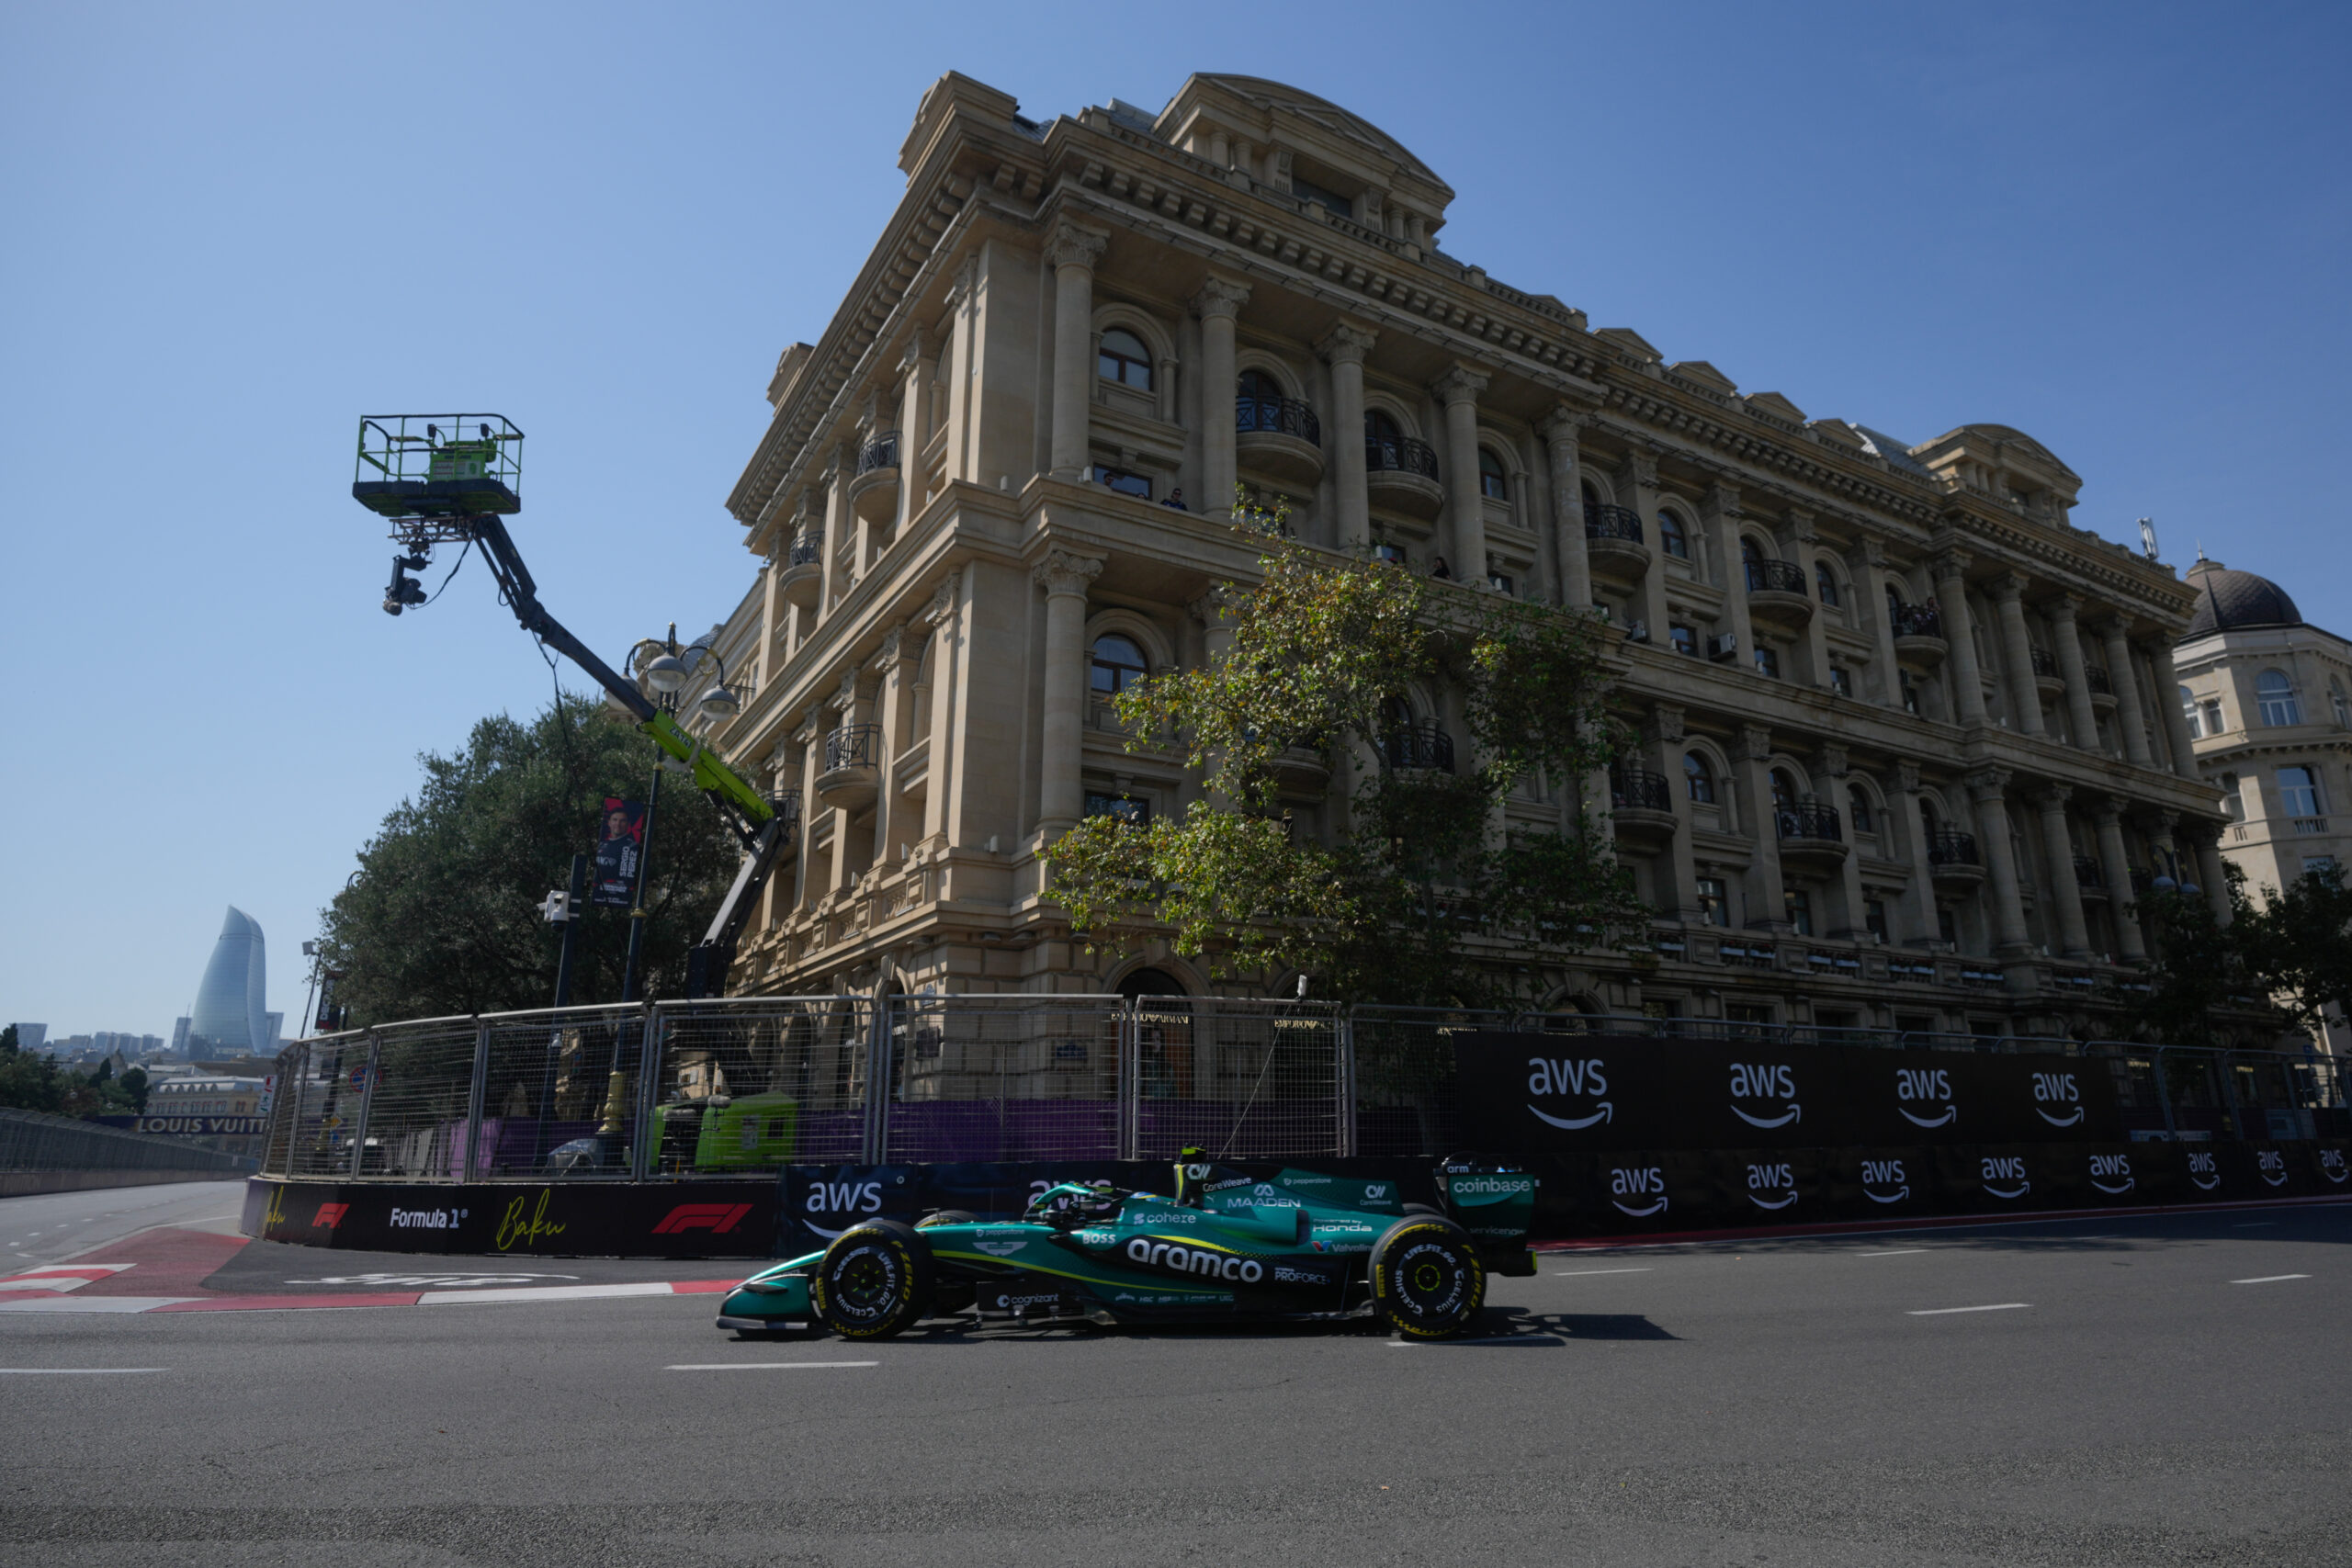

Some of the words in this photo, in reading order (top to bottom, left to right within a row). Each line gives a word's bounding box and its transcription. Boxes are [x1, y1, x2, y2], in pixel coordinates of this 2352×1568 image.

[619, 846, 630, 877] SERGIO
[627, 851, 638, 878] PEREZ
[1159, 1014, 1189, 1024] ARMANI
[1528, 1057, 1607, 1096] aws
[1730, 1063, 1795, 1099] aws
[1896, 1068, 1951, 1100] aws
[2032, 1072, 2079, 1102] aws
[138, 1118, 202, 1133] LOUIS
[1981, 1156, 2026, 1179] aws
[2089, 1154, 2131, 1177] aws
[2188, 1152, 2215, 1173] aws
[2256, 1151, 2283, 1170] aws
[2319, 1149, 2345, 1168] aws
[1446, 1165, 1469, 1174] arm
[1747, 1163, 1793, 1189] aws
[1861, 1160, 1905, 1184] aws
[1202, 1177, 1252, 1192] CoreWeave
[1293, 1178, 1332, 1186] pepperstone
[1453, 1177, 1531, 1193] coinbase
[1611, 1167, 1664, 1194] aws
[806, 1181, 882, 1213] aws
[1227, 1198, 1301, 1209] MAADEN
[390, 1208, 447, 1228] Formula
[496, 1188, 566, 1250] Baku
[1147, 1213, 1196, 1224] cohere
[986, 1228, 1025, 1236] pepperstone
[1312, 1224, 1373, 1233] Honda
[1470, 1225, 1527, 1235] servicenow
[1082, 1233, 1116, 1245] BOSS
[1332, 1244, 1374, 1253] Valvolin
[1126, 1238, 1263, 1283] aramco
[1011, 1292, 1059, 1306] cognizant
